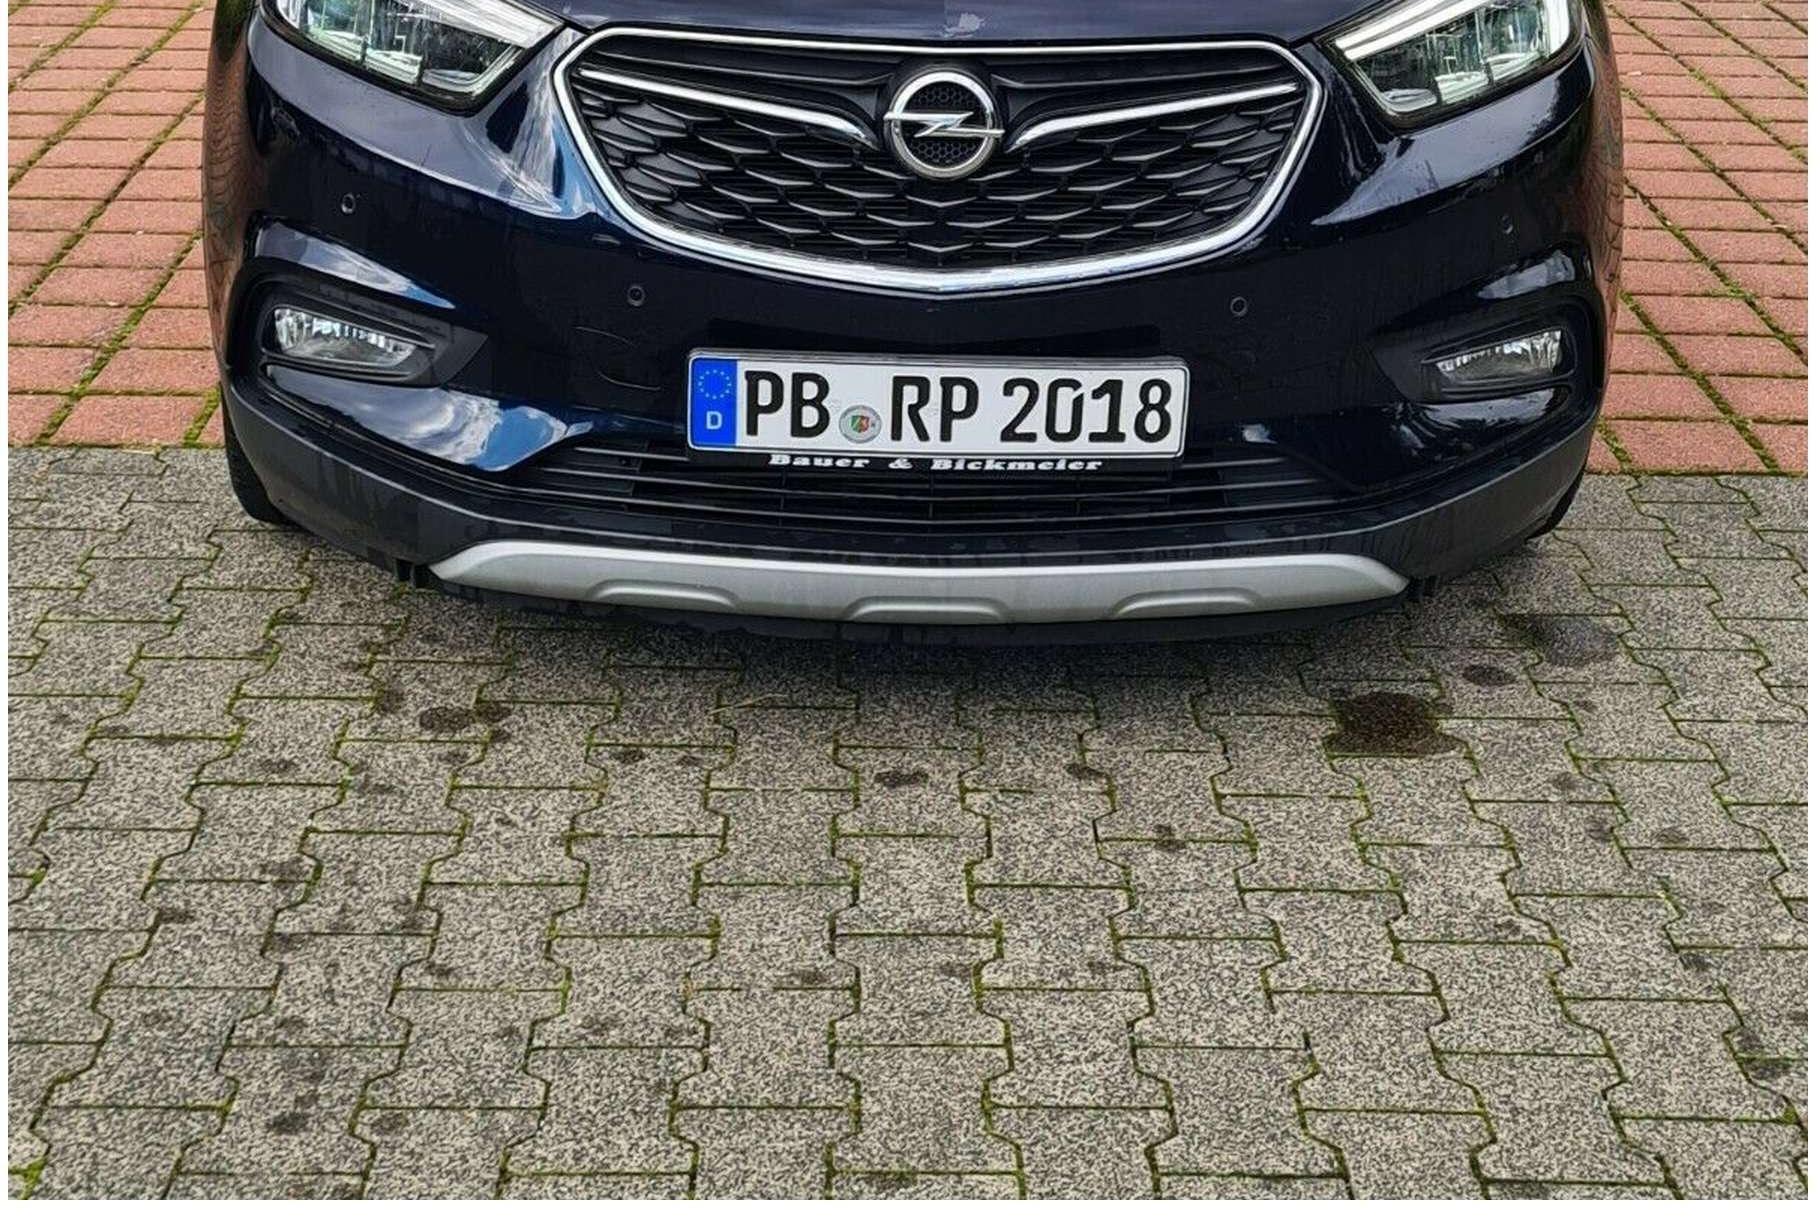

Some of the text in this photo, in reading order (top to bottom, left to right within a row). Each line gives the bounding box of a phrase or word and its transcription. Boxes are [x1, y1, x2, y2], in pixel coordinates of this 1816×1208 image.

[744, 369, 1173, 443] PB RP 2018
[706, 411, 722, 430] D
[769, 453, 1103, 472] Bauer & Bickmeier
